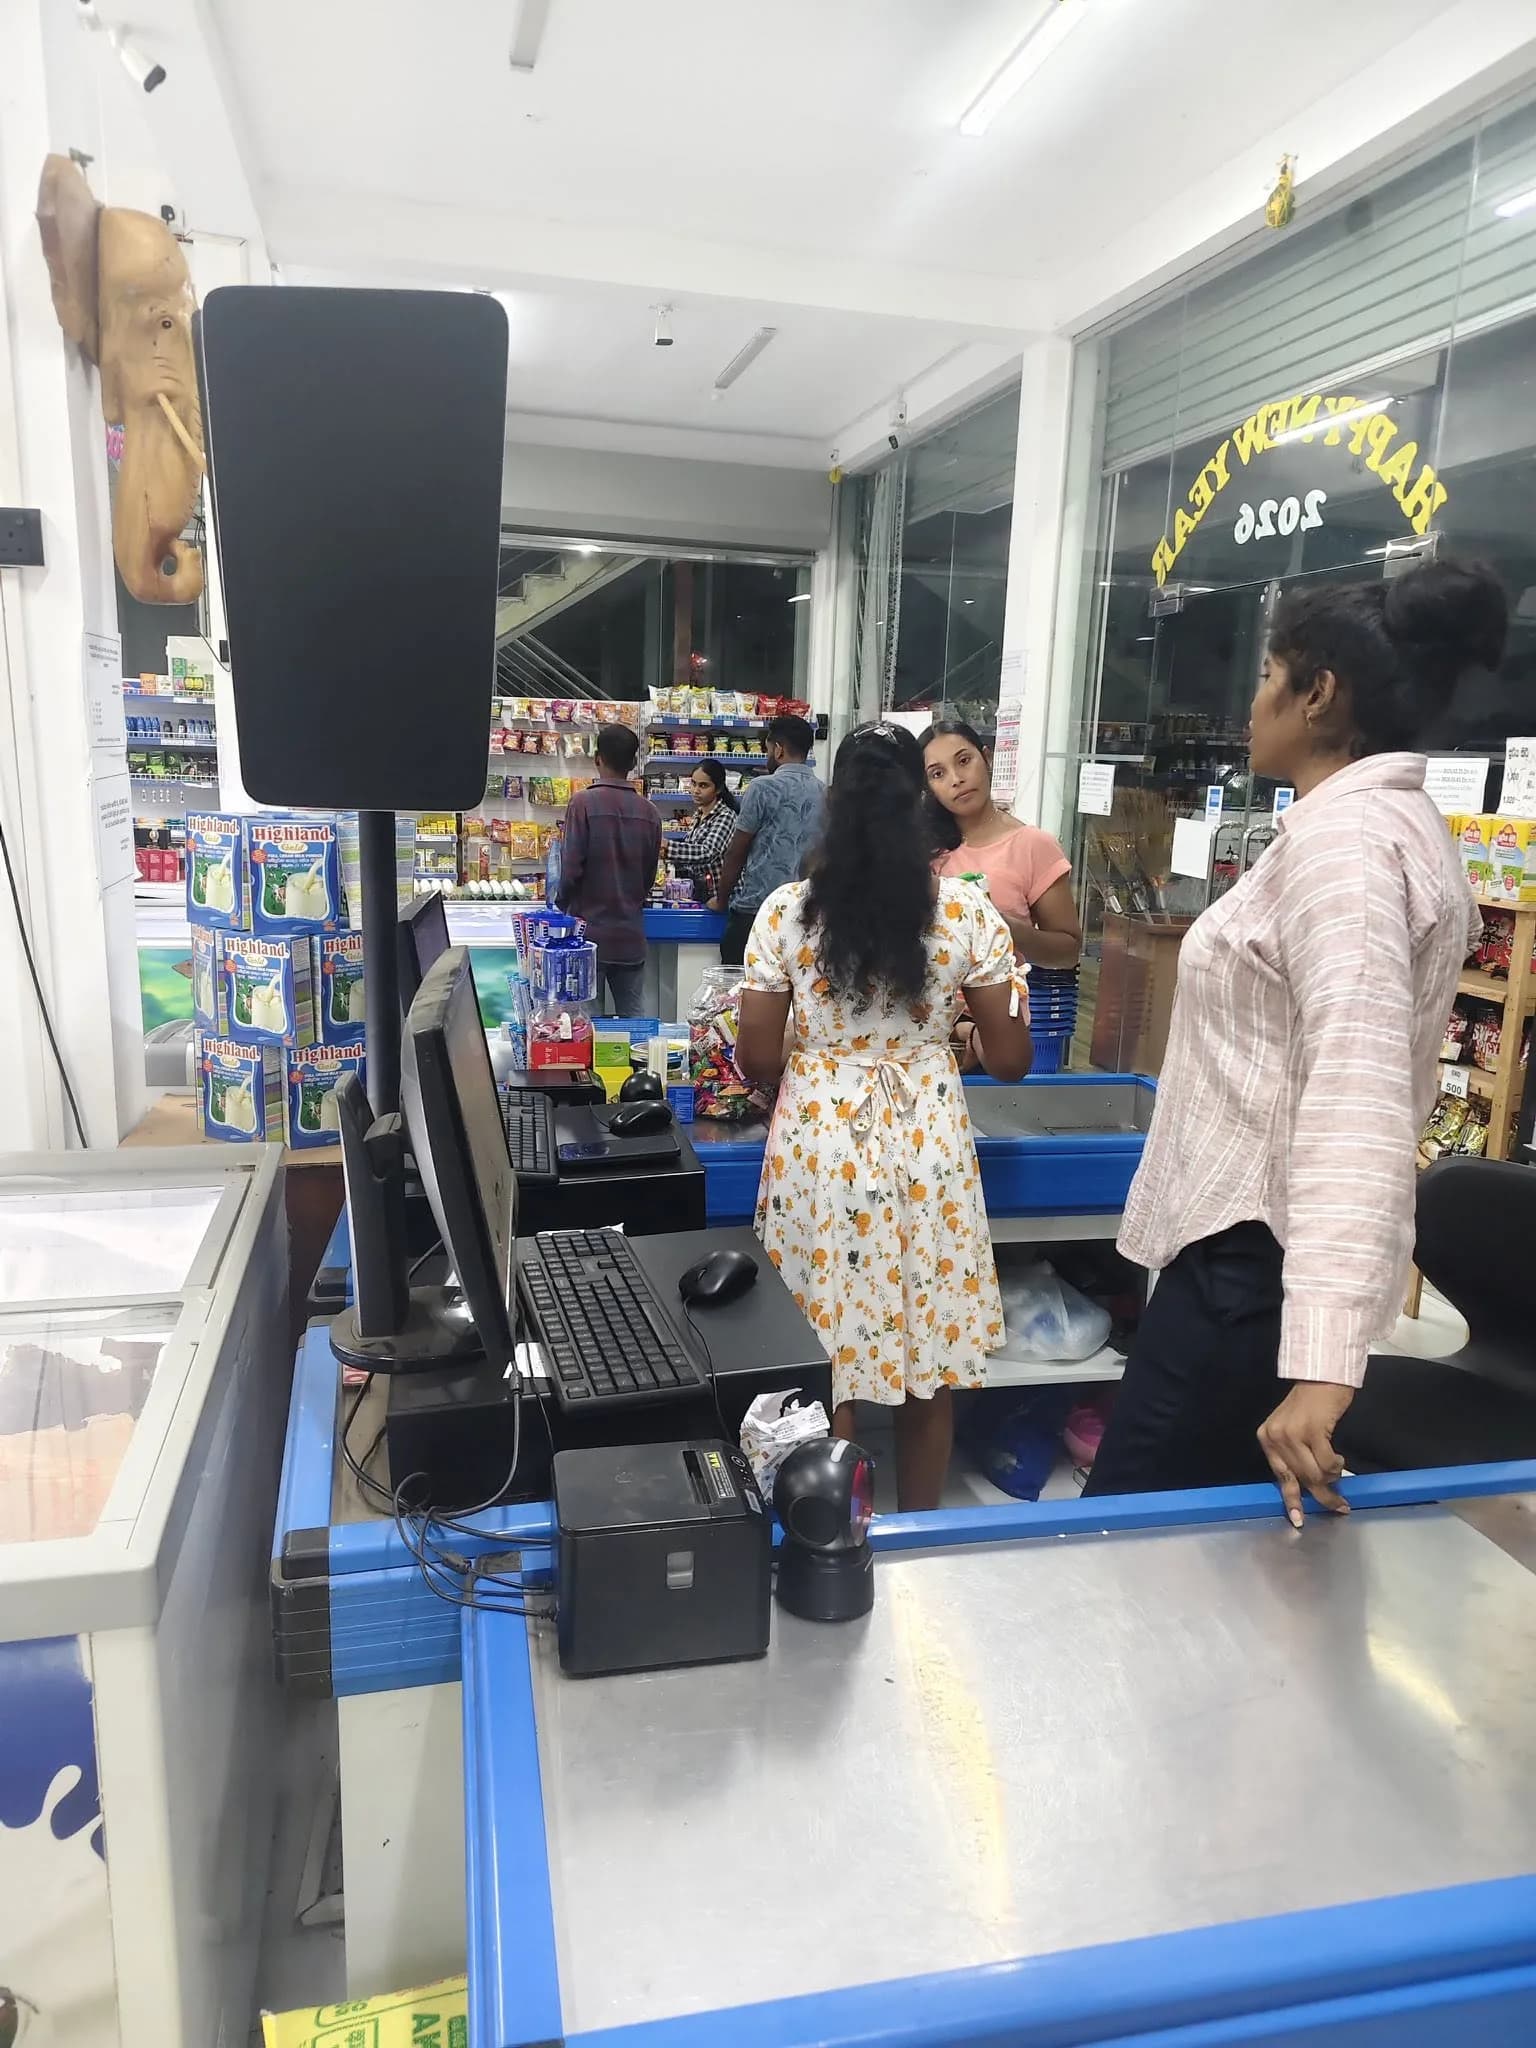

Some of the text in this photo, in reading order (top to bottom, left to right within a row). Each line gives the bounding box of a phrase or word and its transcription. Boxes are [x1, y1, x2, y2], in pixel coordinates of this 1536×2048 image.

[189, 817, 236, 834] Highland
[254, 826, 329, 843] Highland
[226, 939, 285, 957] Highland
[325, 936, 361, 954] Highl
[204, 1039, 256, 1060] Highland
[293, 1045, 363, 1064] Highland
[1446, 1082, 1462, 1095] 500
